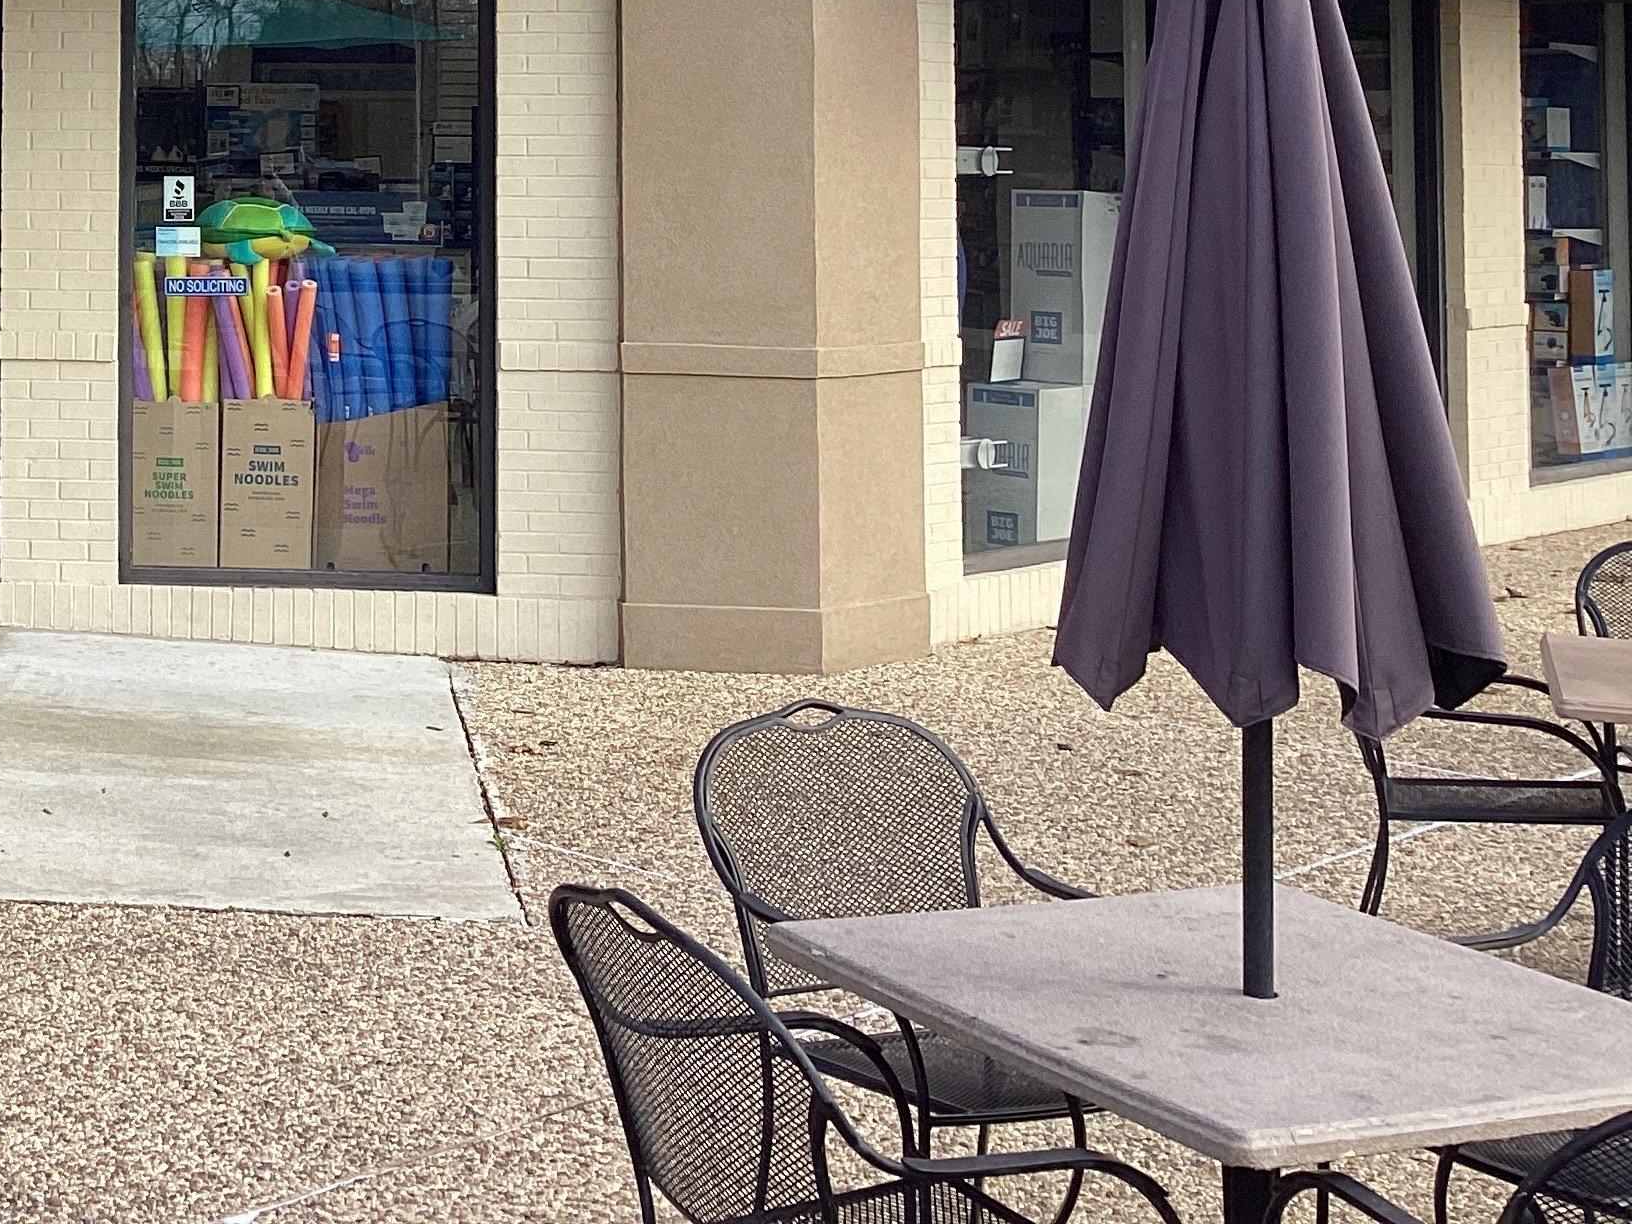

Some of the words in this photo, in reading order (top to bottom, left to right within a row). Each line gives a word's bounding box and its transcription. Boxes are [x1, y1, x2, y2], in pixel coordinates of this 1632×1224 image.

[1017, 241, 1073, 271] AQUARIA
[168, 280, 185, 293] NO
[186, 280, 245, 293] SOLICITING
[1034, 316, 1058, 326] BIG
[1000, 321, 1024, 337] SALE
[1035, 329, 1058, 340] JOE
[248, 460, 285, 473] SWIM
[152, 471, 187, 482] SUPER
[234, 473, 299, 487] NOODLES
[155, 481, 184, 490] SWIM
[144, 489, 194, 499] NOODLES
